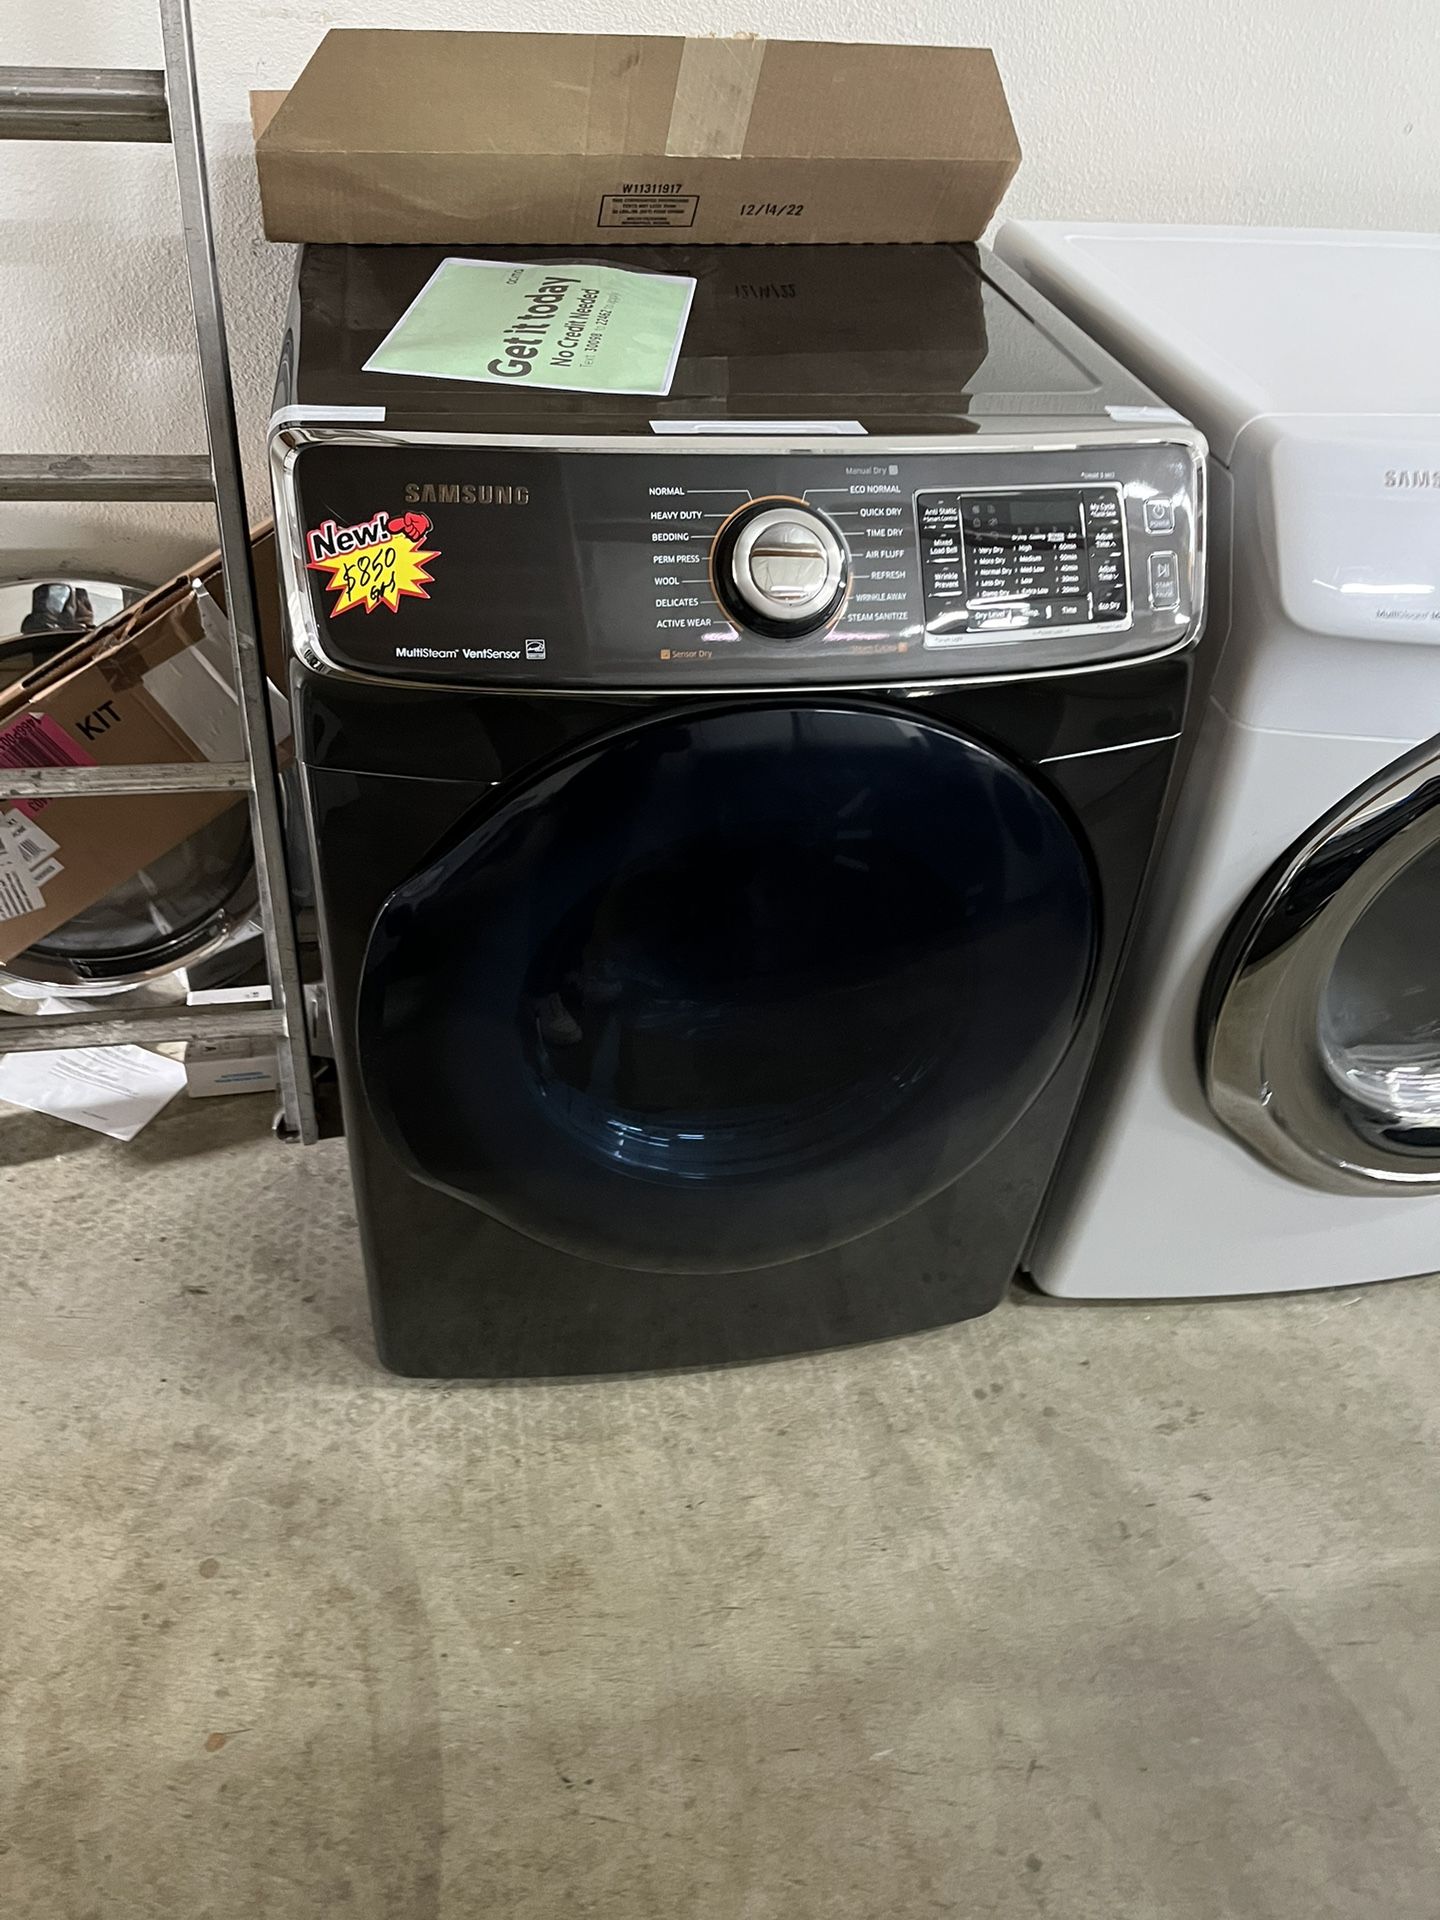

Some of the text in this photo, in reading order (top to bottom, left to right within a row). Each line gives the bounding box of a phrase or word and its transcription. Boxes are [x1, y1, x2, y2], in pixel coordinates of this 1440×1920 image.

[623, 184, 682, 193] W11311917
[740, 204, 804, 216] 12/14/22
[488, 276, 581, 377] Get it today
[550, 288, 600, 367] No Credit Needed
[874, 466, 887, 476] Dry
[405, 483, 529, 505] SAMSUNG
[649, 487, 685, 496] NORMAL
[850, 485, 901, 494] ECO NORMAL
[651, 511, 702, 520] HEAVY DUTY
[860, 508, 902, 517] QUICK DRY
[312, 515, 389, 559] New!
[652, 533, 689, 542] BEDDING
[885, 529, 903, 537] DRY
[866, 550, 905, 559] AIR FLUFF
[993, 546, 1004, 554] Dry
[654, 555, 700, 564] PERM PRESS
[994, 557, 1006, 565] Dry
[871, 571, 906, 580] REFRESH
[934, 572, 958, 580] Wrinkle
[980, 568, 1001, 576] Normal
[654, 577, 679, 585] WOOL
[935, 581, 959, 589] Prevent
[886, 592, 907, 601] AWAY
[656, 598, 698, 607] DELICATES
[847, 612, 908, 622] STEAM SANITIZE
[657, 618, 711, 628] ACTIVE WEAR
[462, 648, 521, 659] VentSensor
[672, 649, 712, 660] Sensor Dry
[75, 700, 122, 741] KIT
